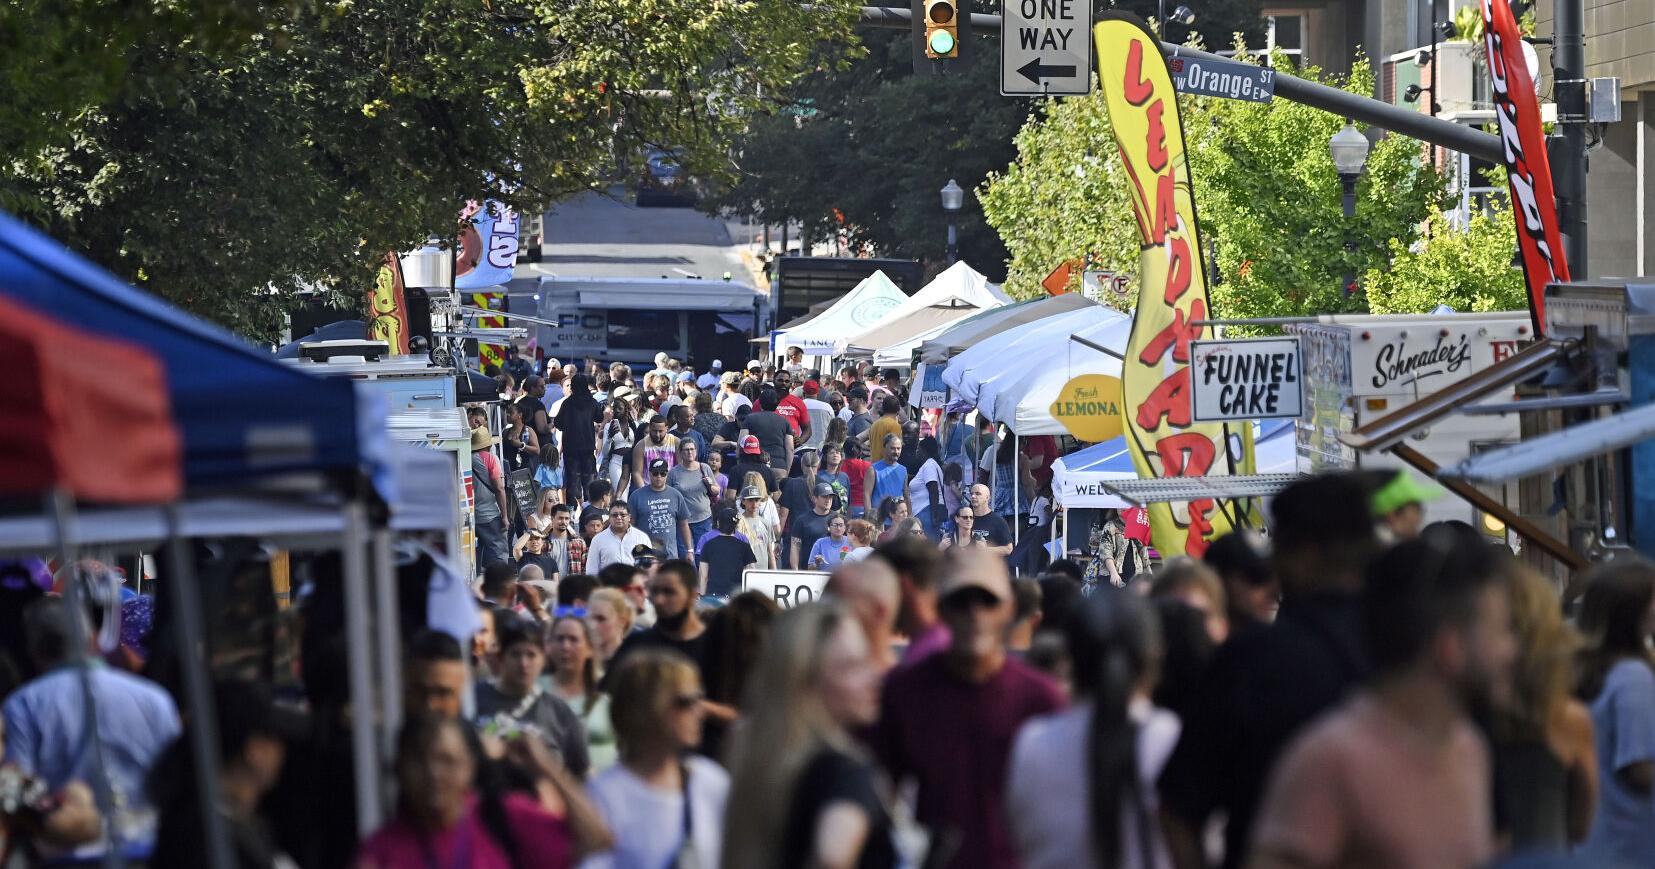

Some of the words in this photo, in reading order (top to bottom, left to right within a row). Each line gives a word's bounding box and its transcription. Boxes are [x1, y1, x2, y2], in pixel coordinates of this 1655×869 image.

[1020, 0, 1074, 20] ONE
[1019, 27, 1074, 51] WAY
[1187, 63, 1253, 99] Orange
[1260, 69, 1274, 84] ST
[1204, 352, 1297, 386] FUNNEL
[1372, 334, 1472, 389] Schnader's
[1074, 385, 1099, 401] Fresh
[1219, 383, 1280, 416] CAKE
[1056, 401, 1121, 417] LEMONA
[773, 584, 813, 609] RO
